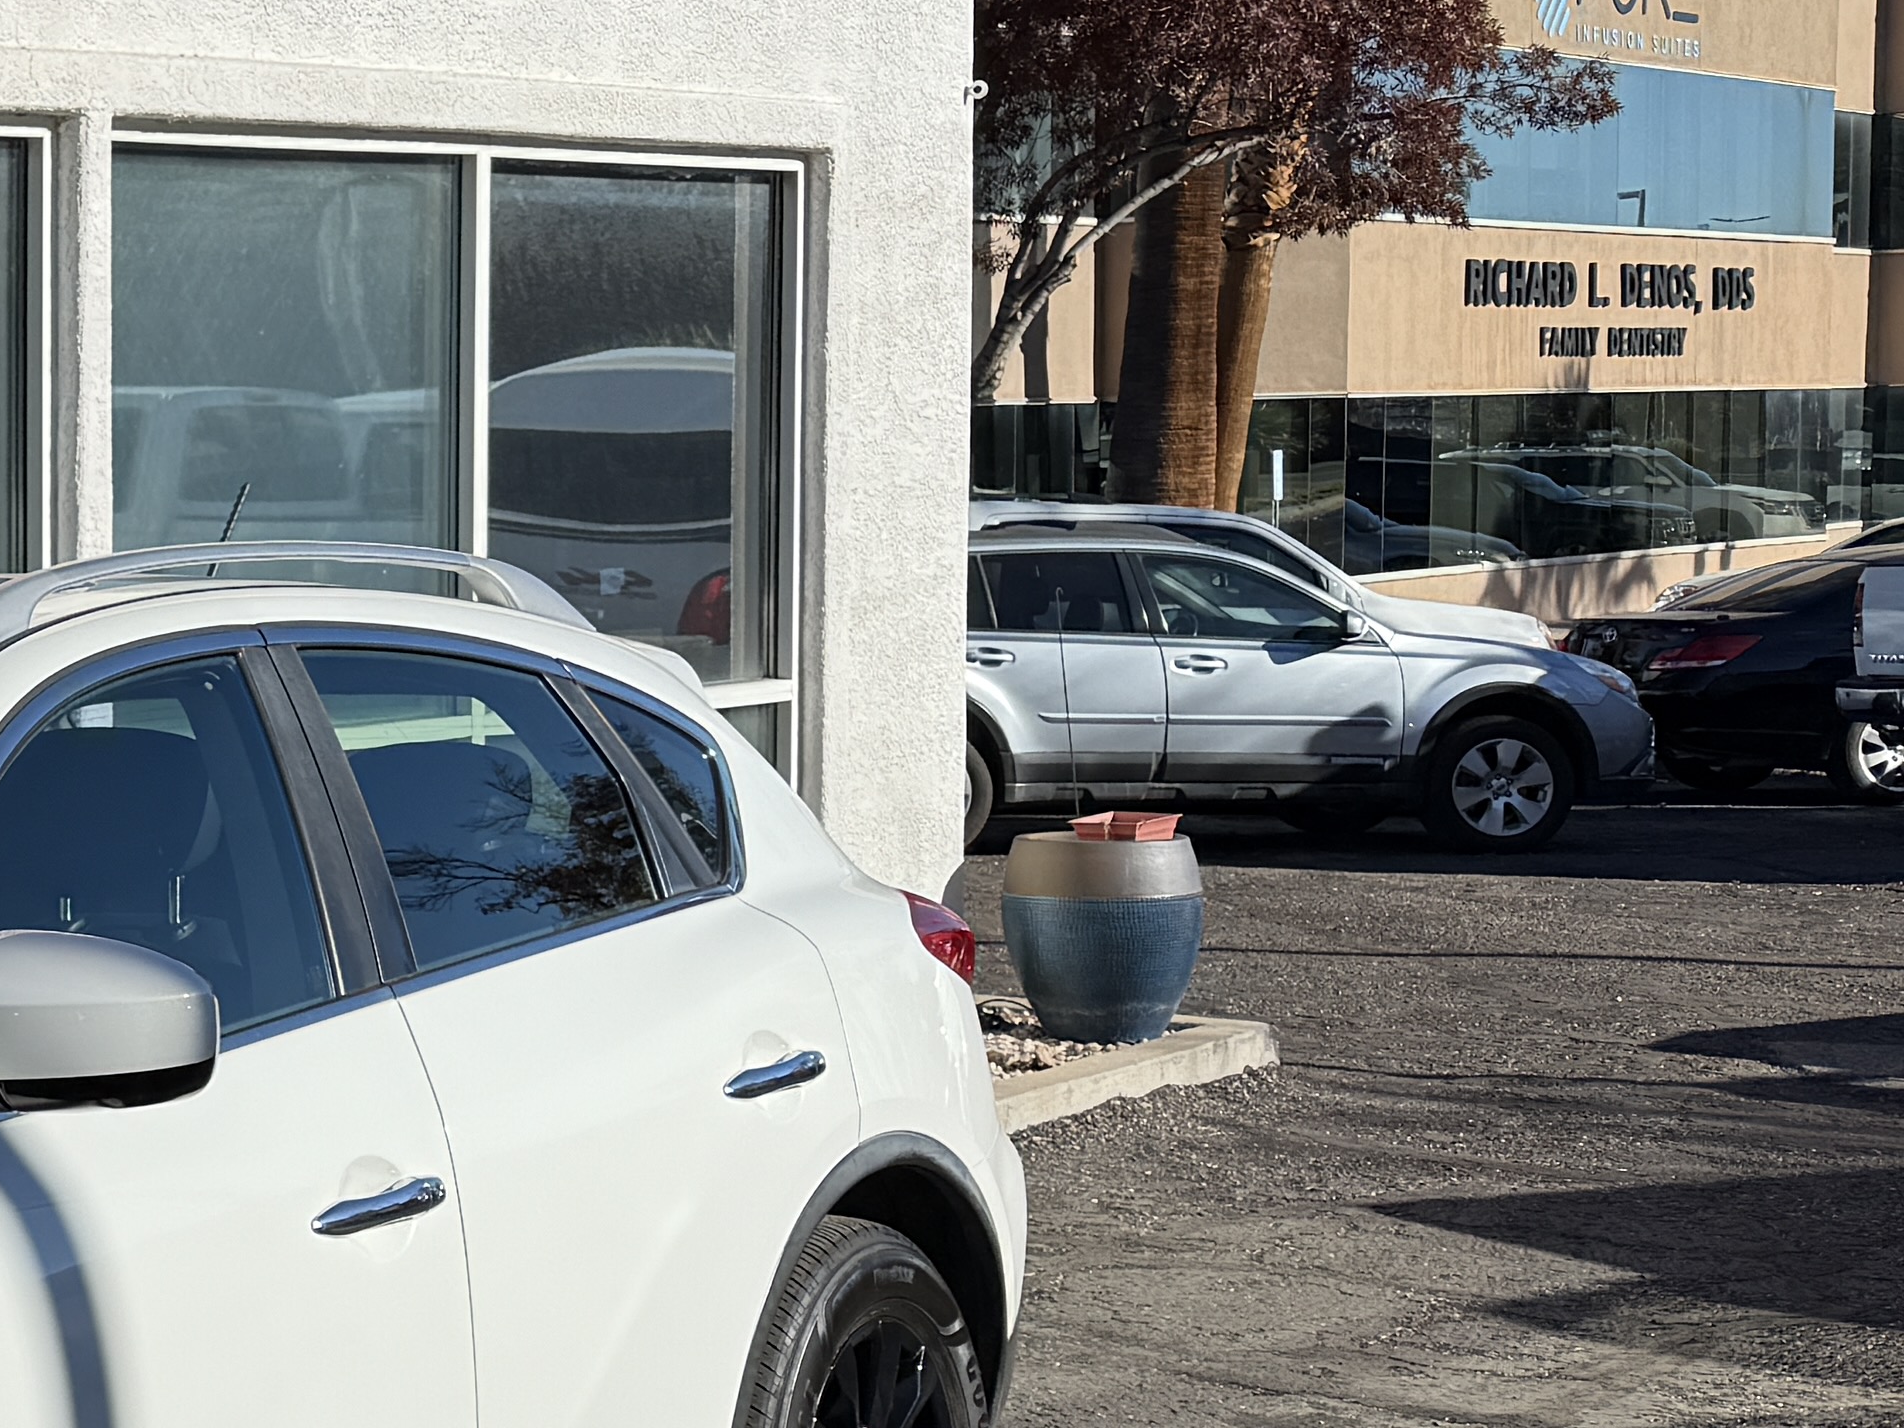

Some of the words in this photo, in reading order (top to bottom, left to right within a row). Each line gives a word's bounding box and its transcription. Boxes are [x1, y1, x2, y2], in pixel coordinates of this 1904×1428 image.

[1575, 23, 1645, 51] INFUSION
[1651, 34, 1701, 59] SUITES
[1464, 258, 1578, 308] RICHARD
[1588, 262, 1611, 308] L.
[1620, 262, 1703, 316] DENOS,
[1712, 266, 1755, 311] DDS
[1539, 326, 1600, 358] FAMILY
[1607, 326, 1688, 358] DENTISTRY
